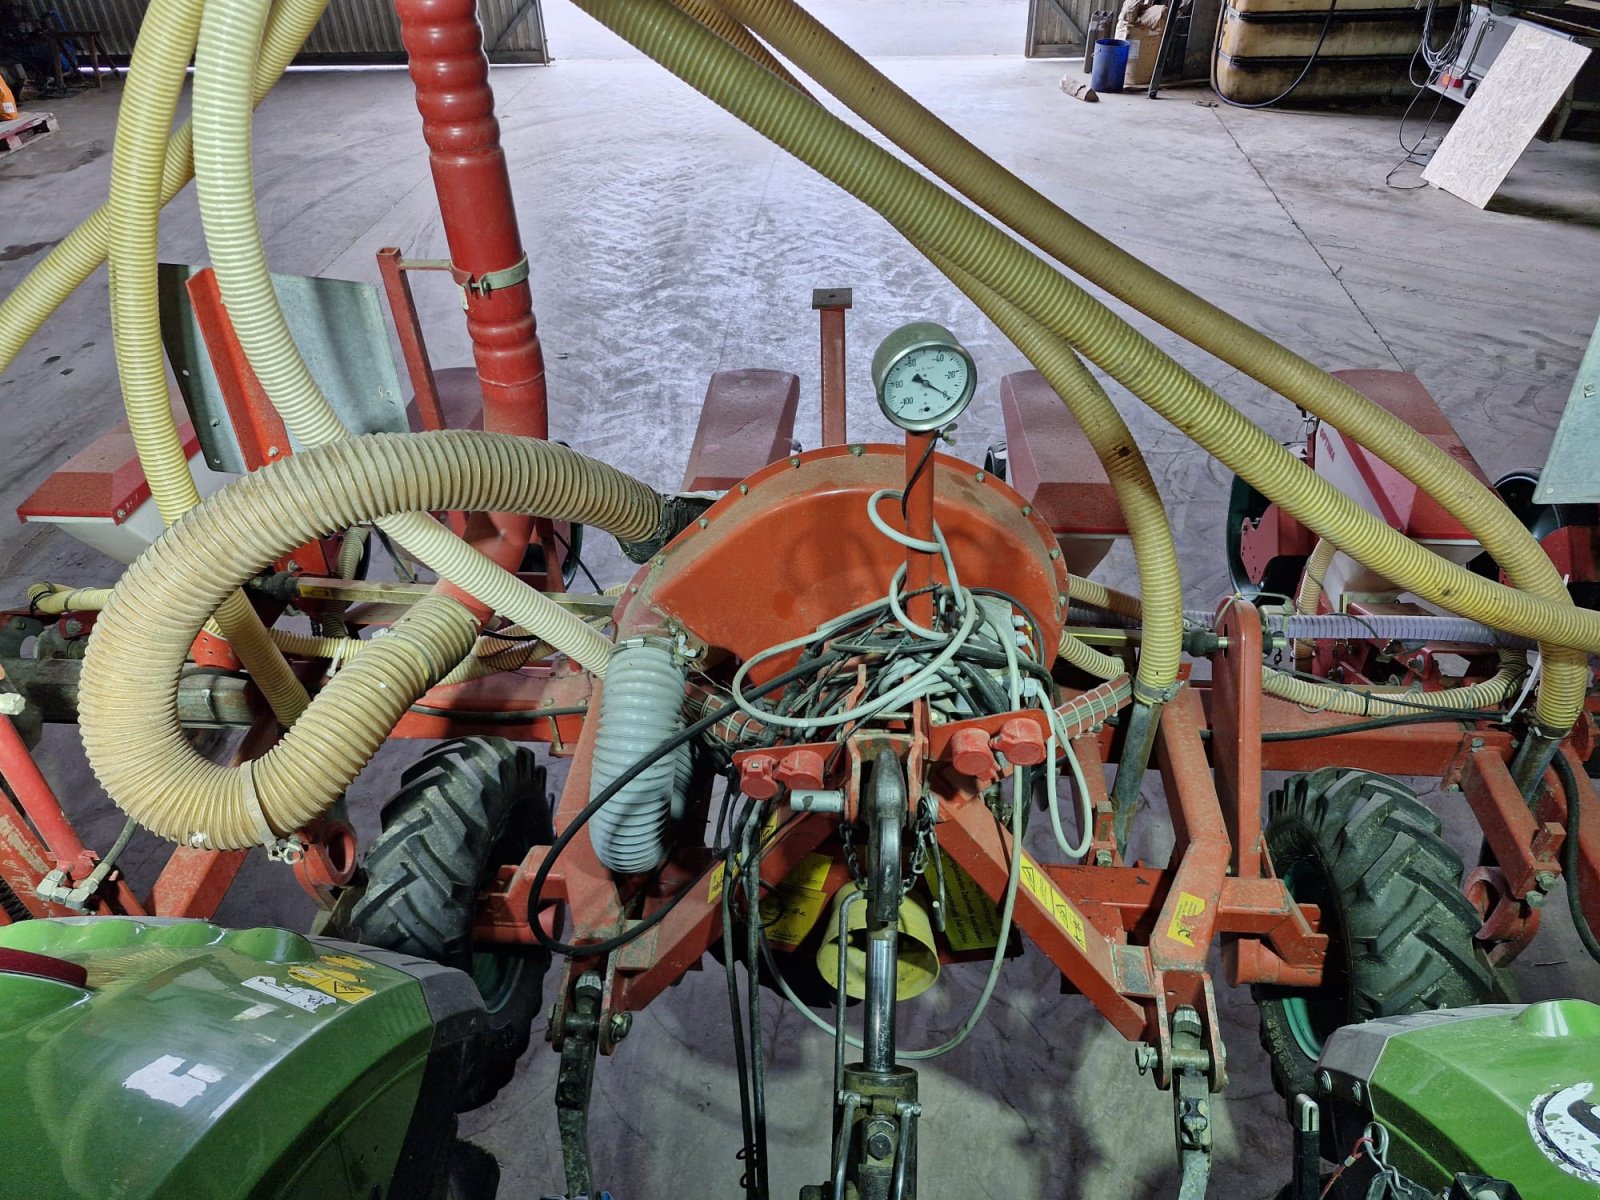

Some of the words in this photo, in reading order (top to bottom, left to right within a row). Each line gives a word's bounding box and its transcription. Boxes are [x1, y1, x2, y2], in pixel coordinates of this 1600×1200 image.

[932, 354, 944, 362] -40
[945, 371, 955, 379] -20
[900, 397, 914, 405] -100
[1320, 428, 1335, 462] OPTIMA
